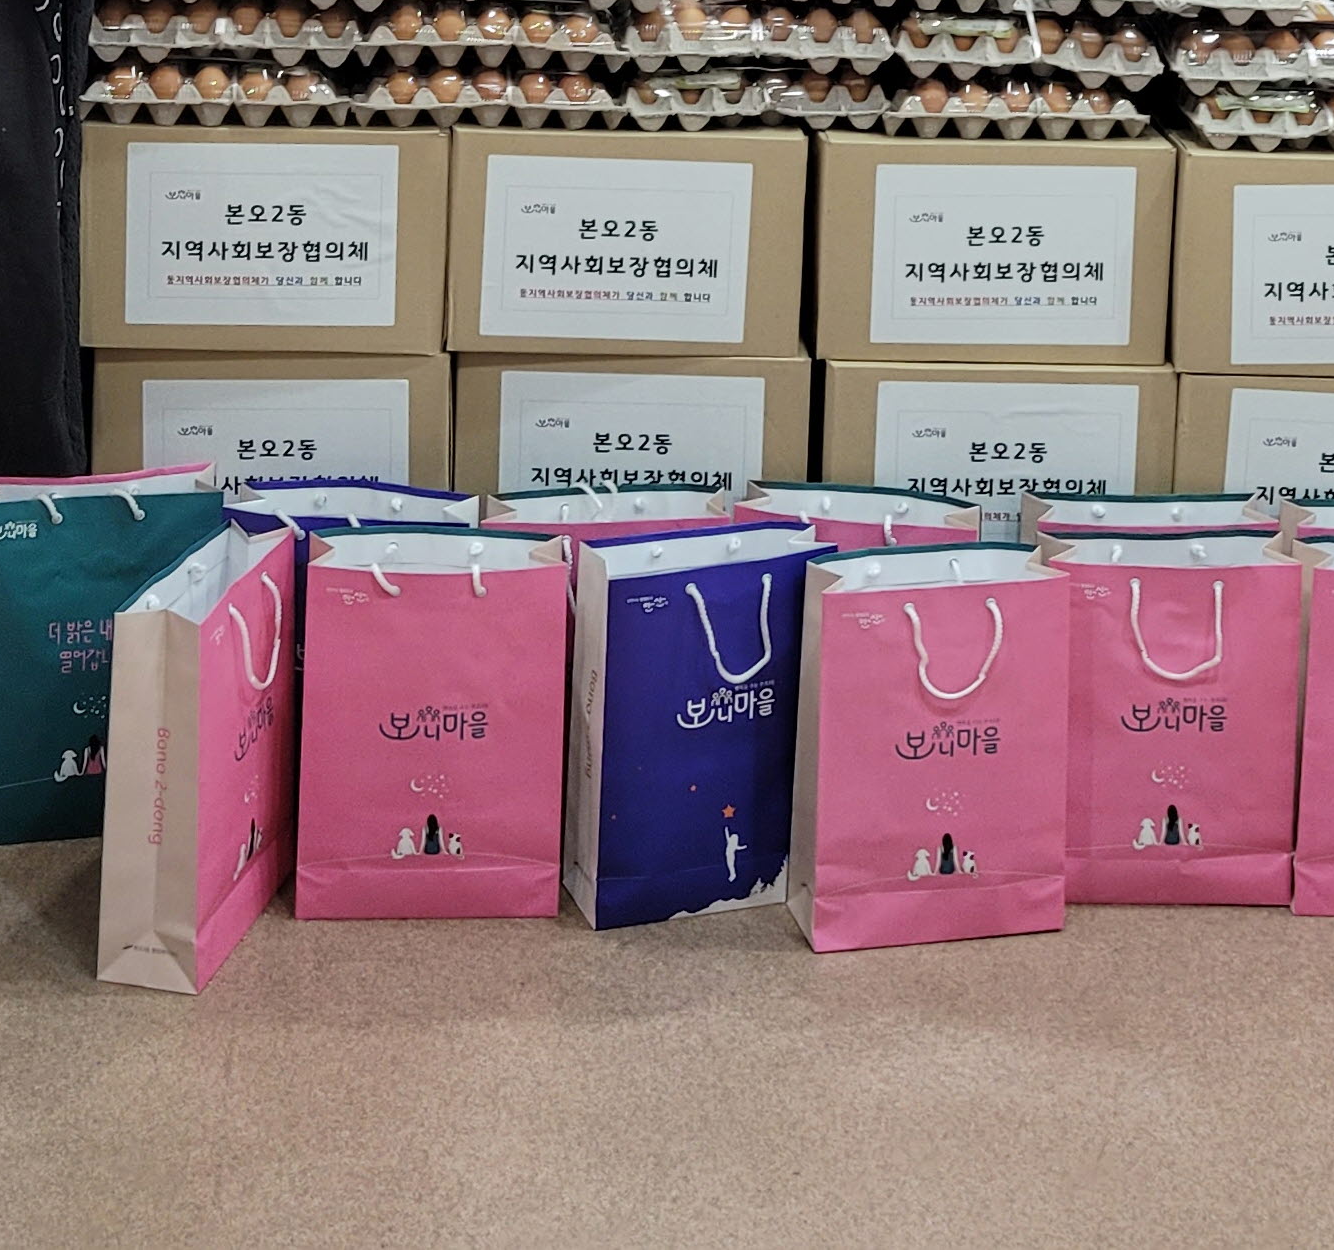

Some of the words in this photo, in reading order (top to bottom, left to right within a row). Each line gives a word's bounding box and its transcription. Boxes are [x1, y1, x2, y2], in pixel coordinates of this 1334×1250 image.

[225, 204, 307, 226] 본오2동
[579, 218, 659, 242] 본오2동
[966, 225, 1045, 247] 본오2동
[161, 240, 369, 263] 지역사회보장협의체
[515, 253, 718, 279] 지역사회보장협의체
[905, 261, 1104, 284] 지역사회보장협의체
[237, 439, 317, 461] 본오2동
[593, 432, 672, 455] 본오2동
[969, 441, 1048, 464] 본오2동
[48, 621, 61, 646] 더
[66, 619, 96, 645] 밝은
